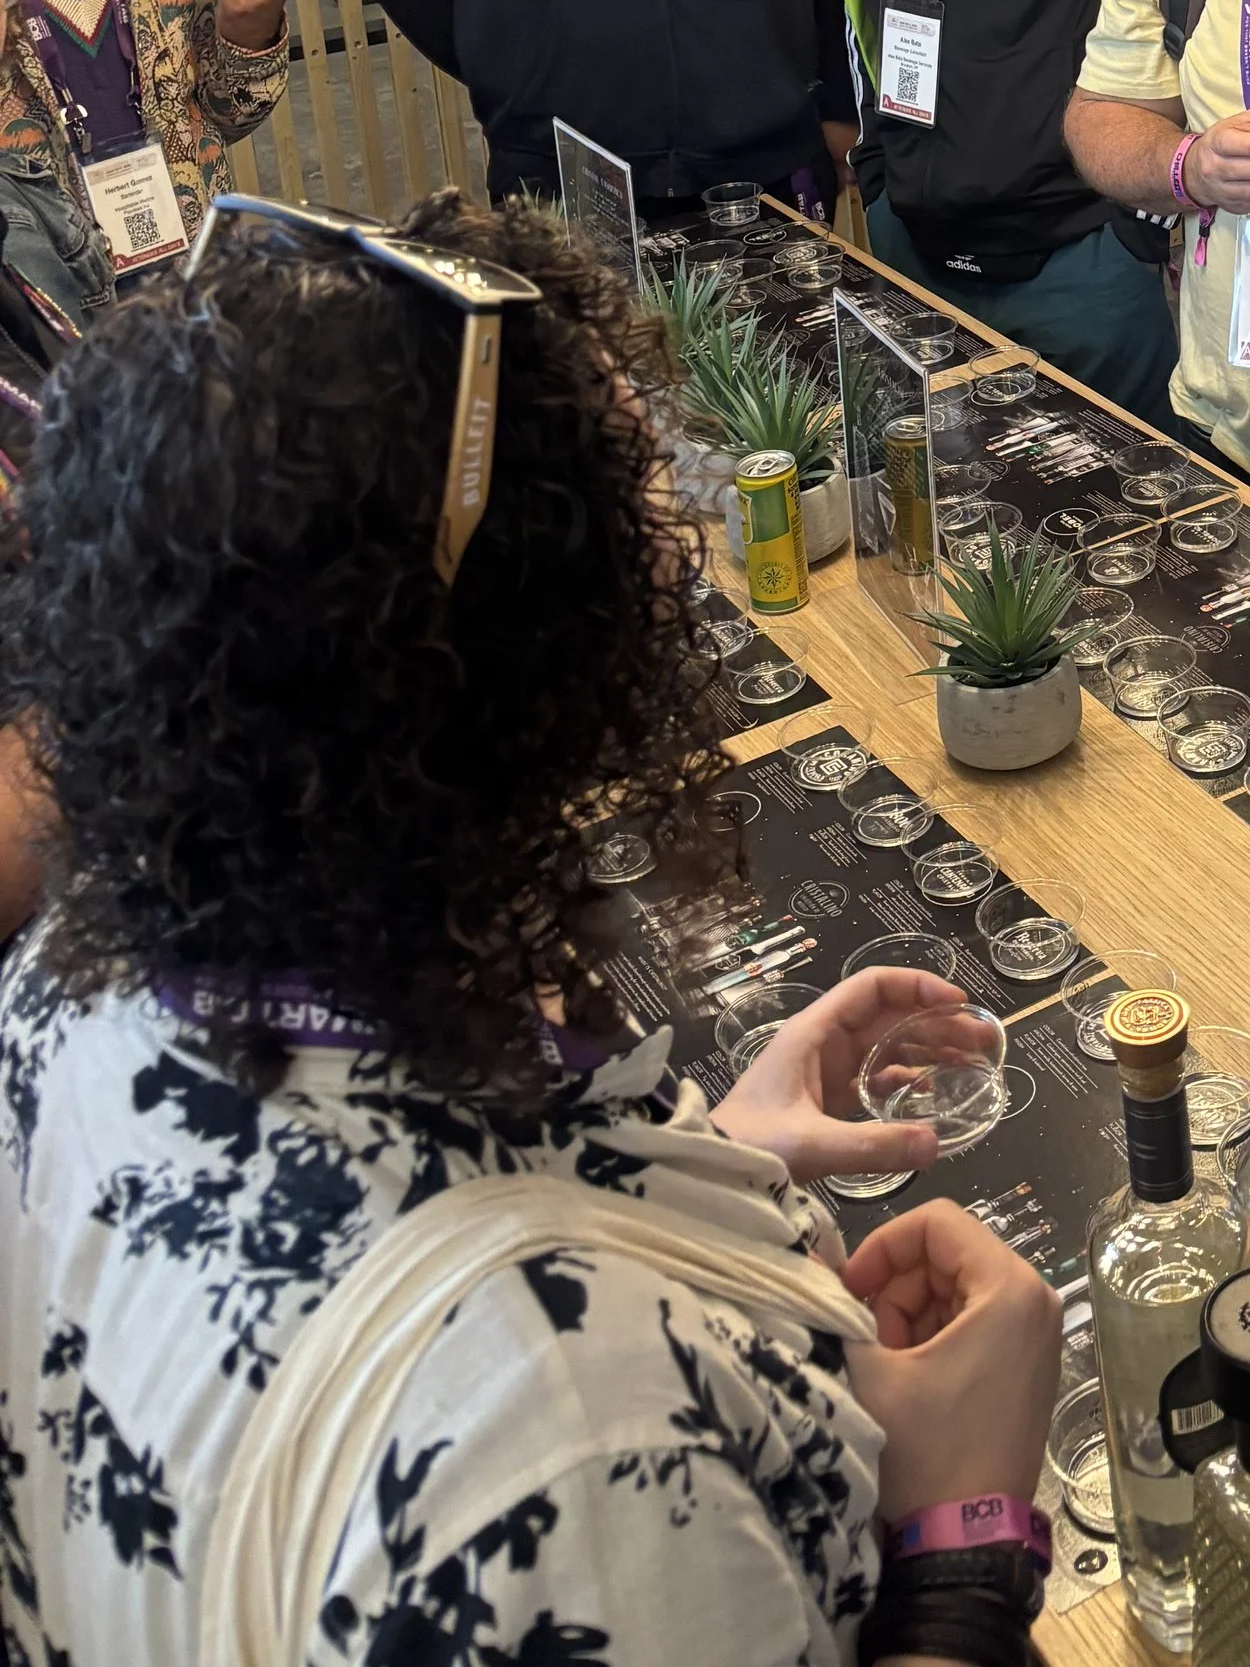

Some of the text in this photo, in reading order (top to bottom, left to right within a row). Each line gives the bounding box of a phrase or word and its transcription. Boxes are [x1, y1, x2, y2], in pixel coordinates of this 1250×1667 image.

[26, 17, 42, 42] BCB
[884, 96, 889, 107] A
[105, 182, 130, 195] Herbert
[116, 257, 125, 268] A
[946, 260, 982, 273] adidas
[461, 398, 493, 507] BULLEIT
[1060, 513, 1082, 529] OBEL
[801, 880, 842, 917] CRISTALINO
[961, 1498, 1003, 1523] BCB
